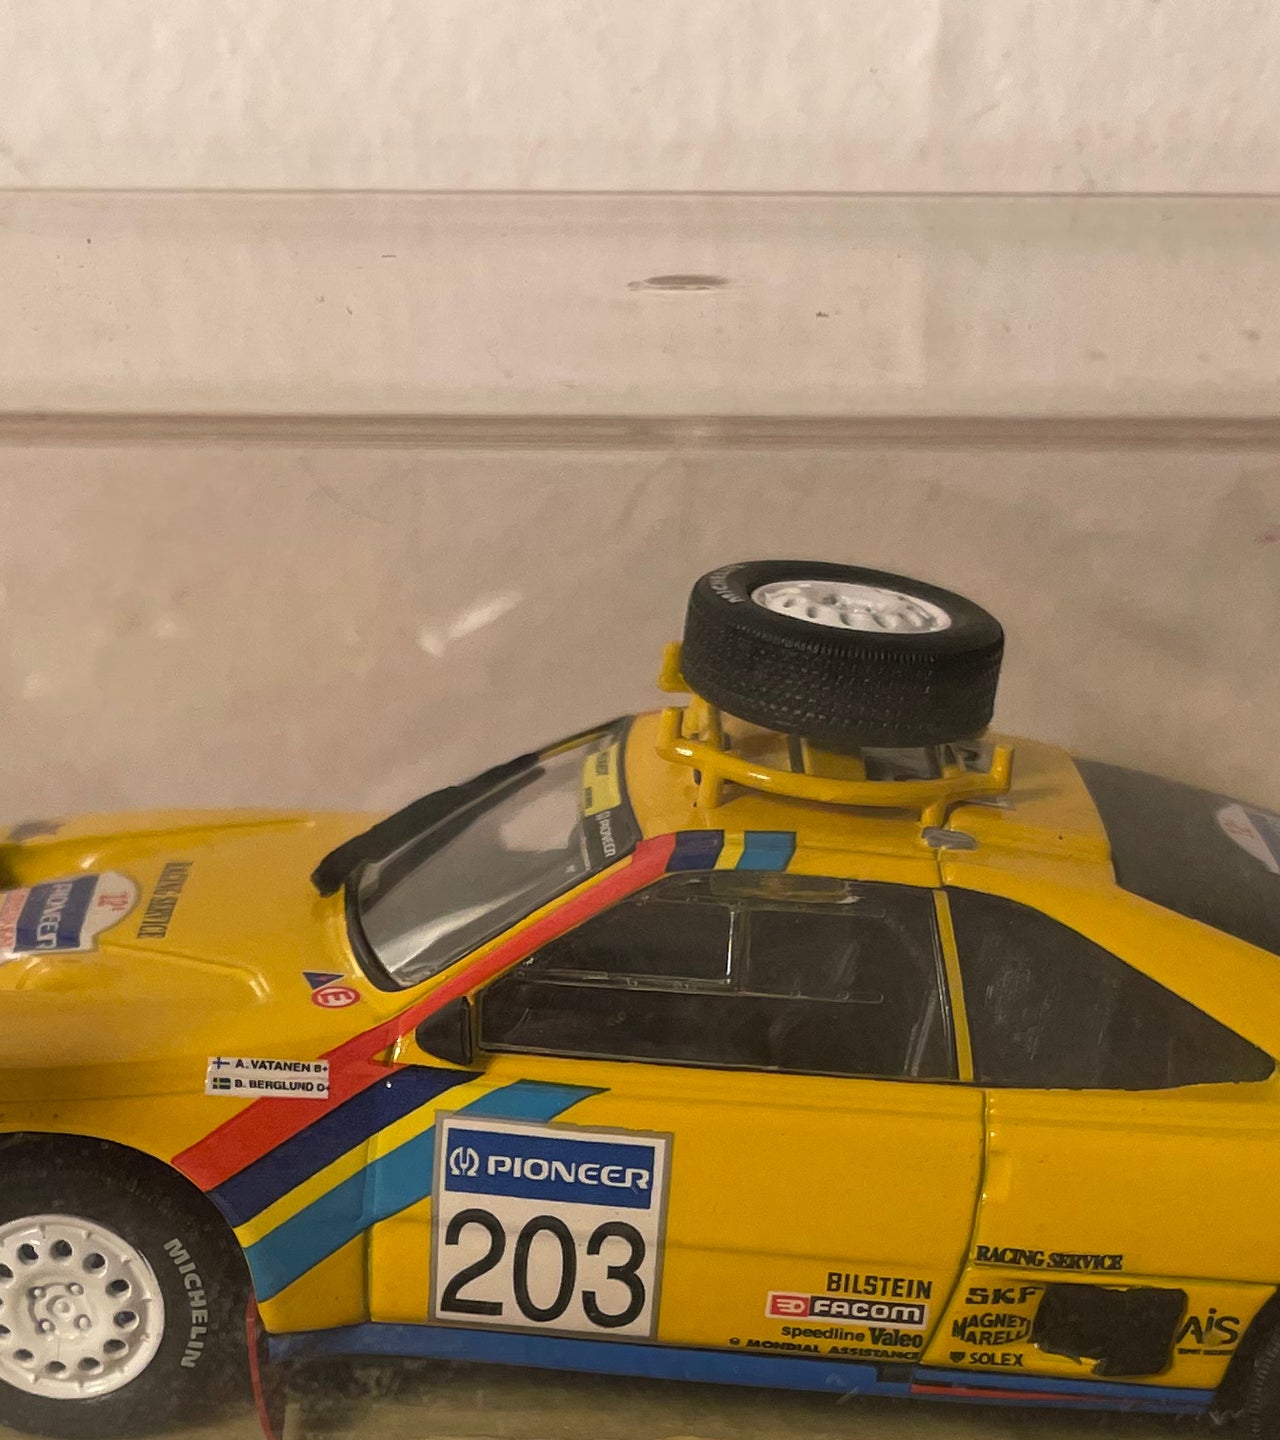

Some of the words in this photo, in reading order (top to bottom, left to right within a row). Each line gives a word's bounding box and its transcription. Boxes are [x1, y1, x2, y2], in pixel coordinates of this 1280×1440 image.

[249, 1080, 314, 1092] BERGLUND
[487, 1155, 650, 1190] PIONEER
[440, 1207, 646, 1329] 203
[974, 1244, 1045, 1267] RACING
[1046, 1252, 1123, 1271] SERVICE
[826, 1271, 933, 1299] BILSTEIN
[965, 1286, 1045, 1305] SKF
[163, 1237, 208, 1368] MICHELIN
[781, 1326, 865, 1342] speedline
[868, 1327, 923, 1348] Valeo
[968, 1352, 1024, 1367] SOLEX
